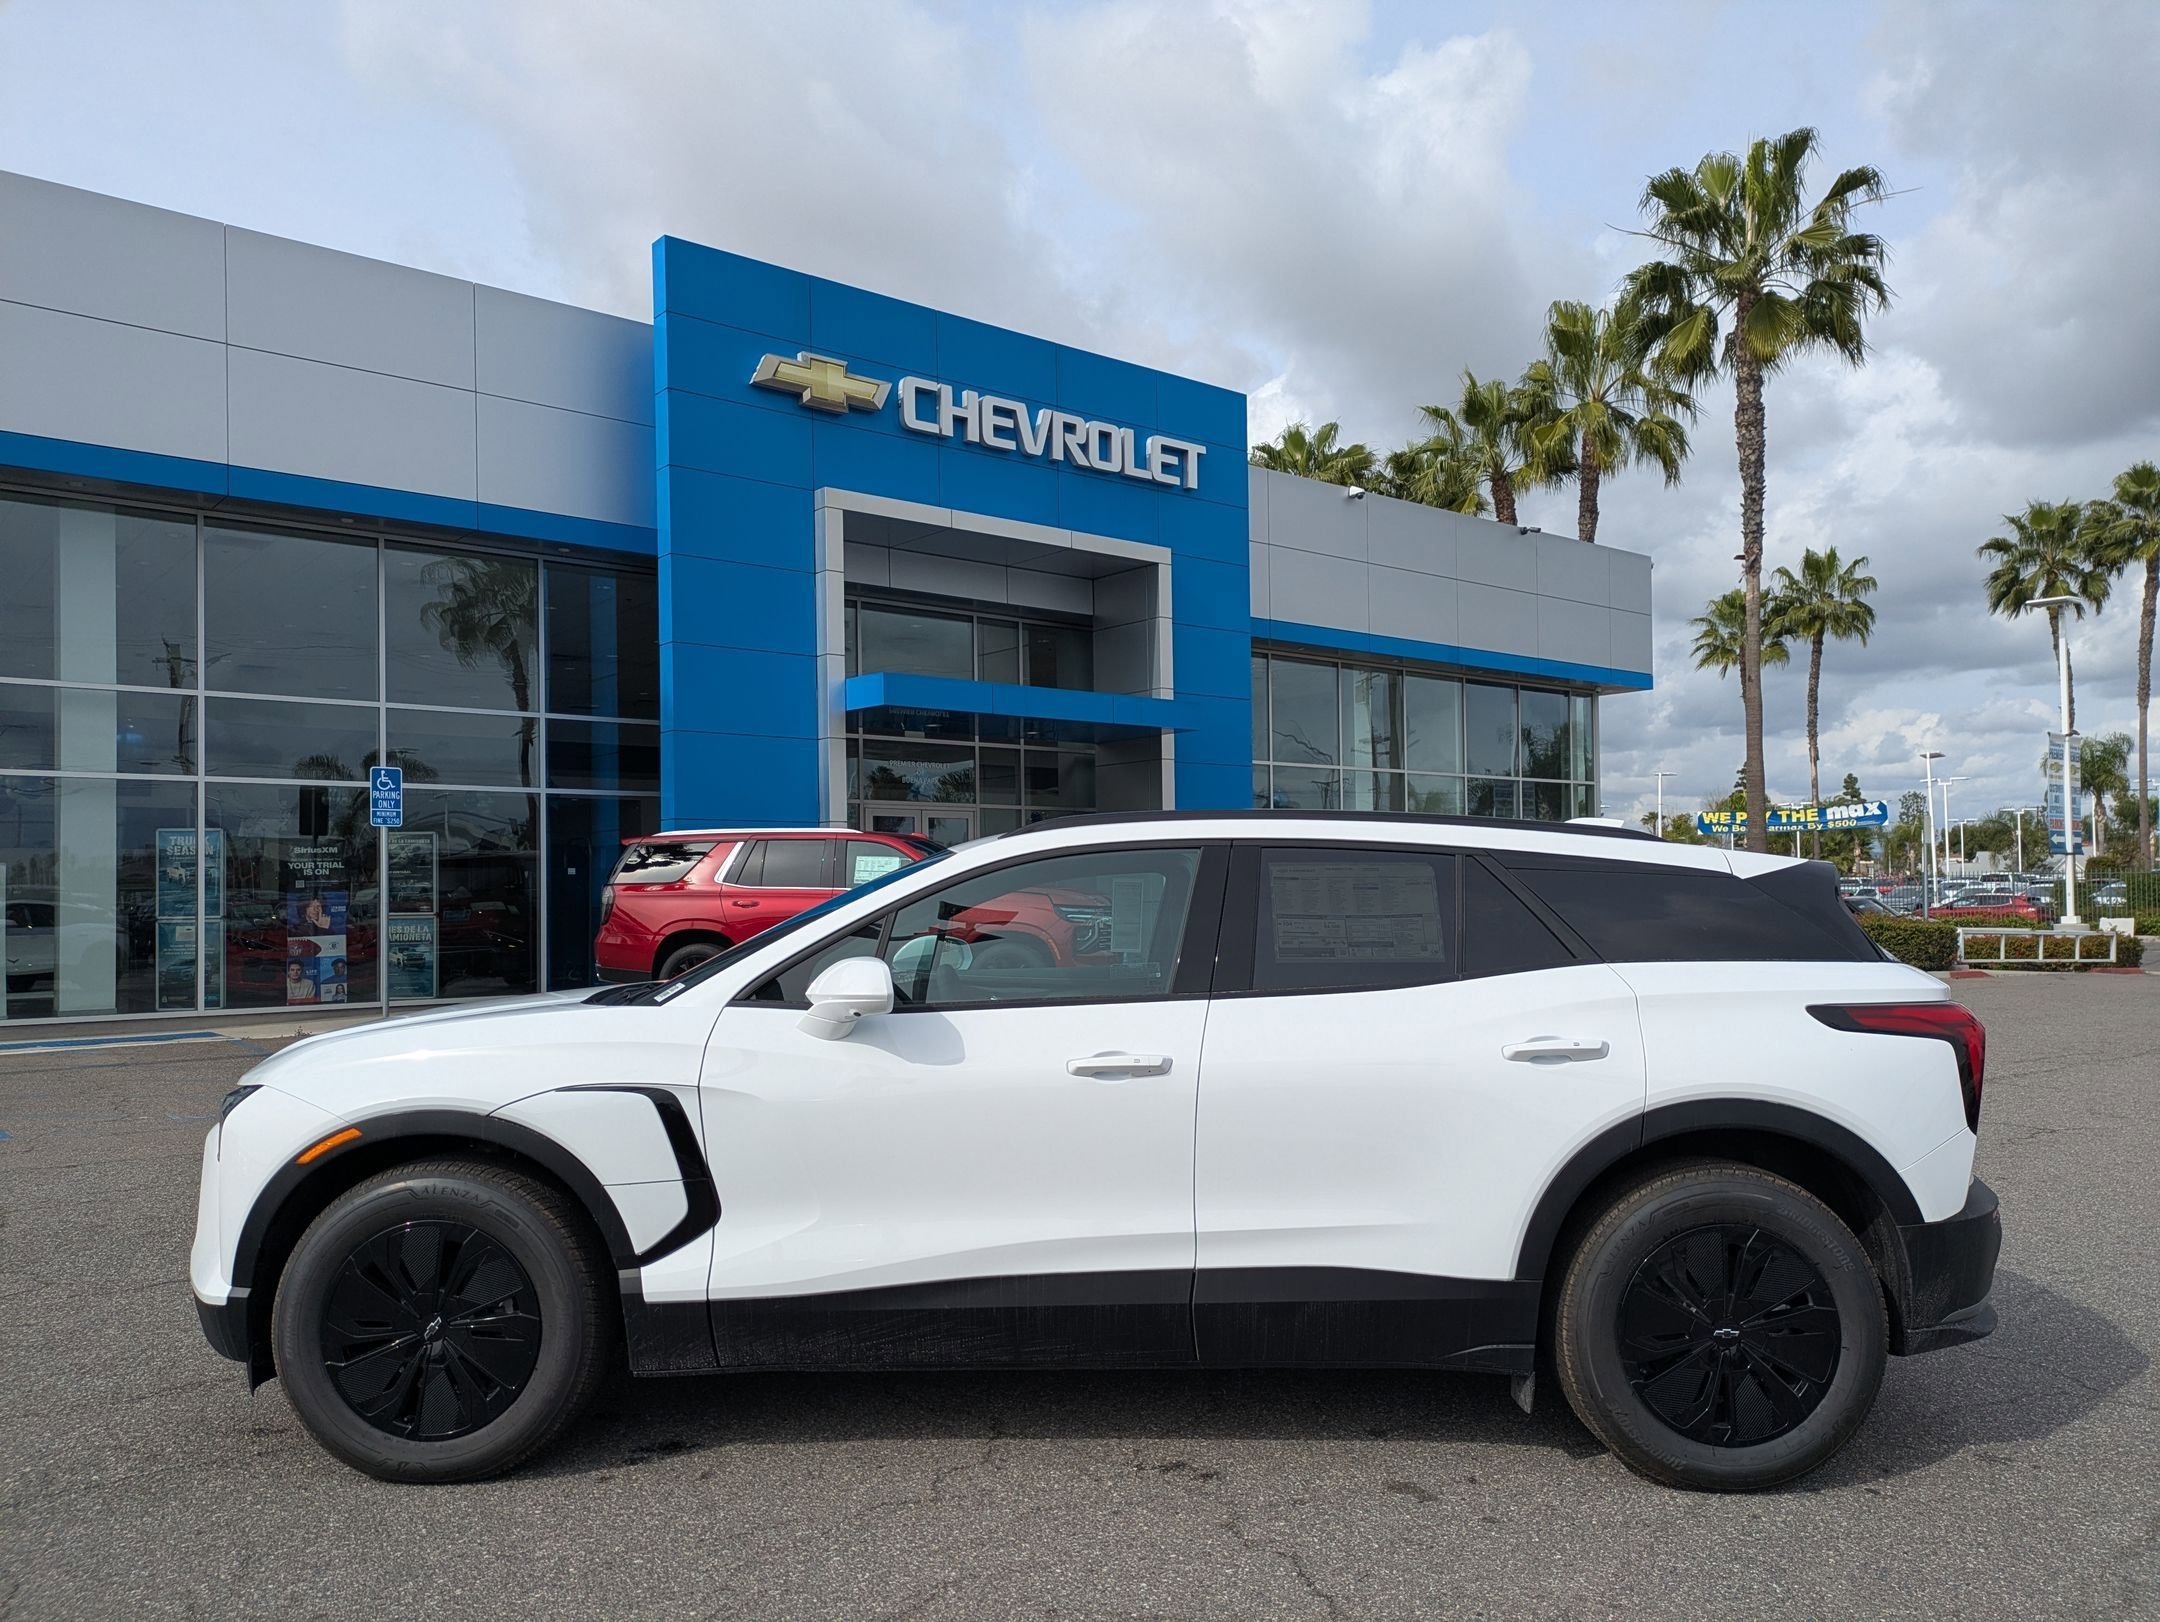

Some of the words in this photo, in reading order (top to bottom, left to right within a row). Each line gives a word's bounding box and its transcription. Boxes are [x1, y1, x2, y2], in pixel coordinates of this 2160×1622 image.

[898, 375, 1207, 490] CHEVROLET
[889, 760, 916, 768] PREMIER
[916, 761, 950, 769] CHEVROLET
[372, 790, 400, 800] PARKING
[378, 800, 395, 809] ONLY
[1702, 811, 1731, 824] WE
[1777, 808, 1819, 823] THE
[1826, 801, 1882, 820] max
[1711, 824, 1729, 833] We
[1807, 823, 1823, 831] By
[1827, 819, 1857, 828] $500
[166, 845, 214, 856] SEASN
[294, 846, 338, 854] SiriusXM
[287, 862, 315, 870] YOUR
[316, 861, 345, 869] TRIAL
[303, 868, 313, 876] IS
[314, 868, 330, 876] ON
[403, 925, 416, 933] DE
[417, 924, 429, 933] LA
[421, 1183, 480, 1202] ALENZA
